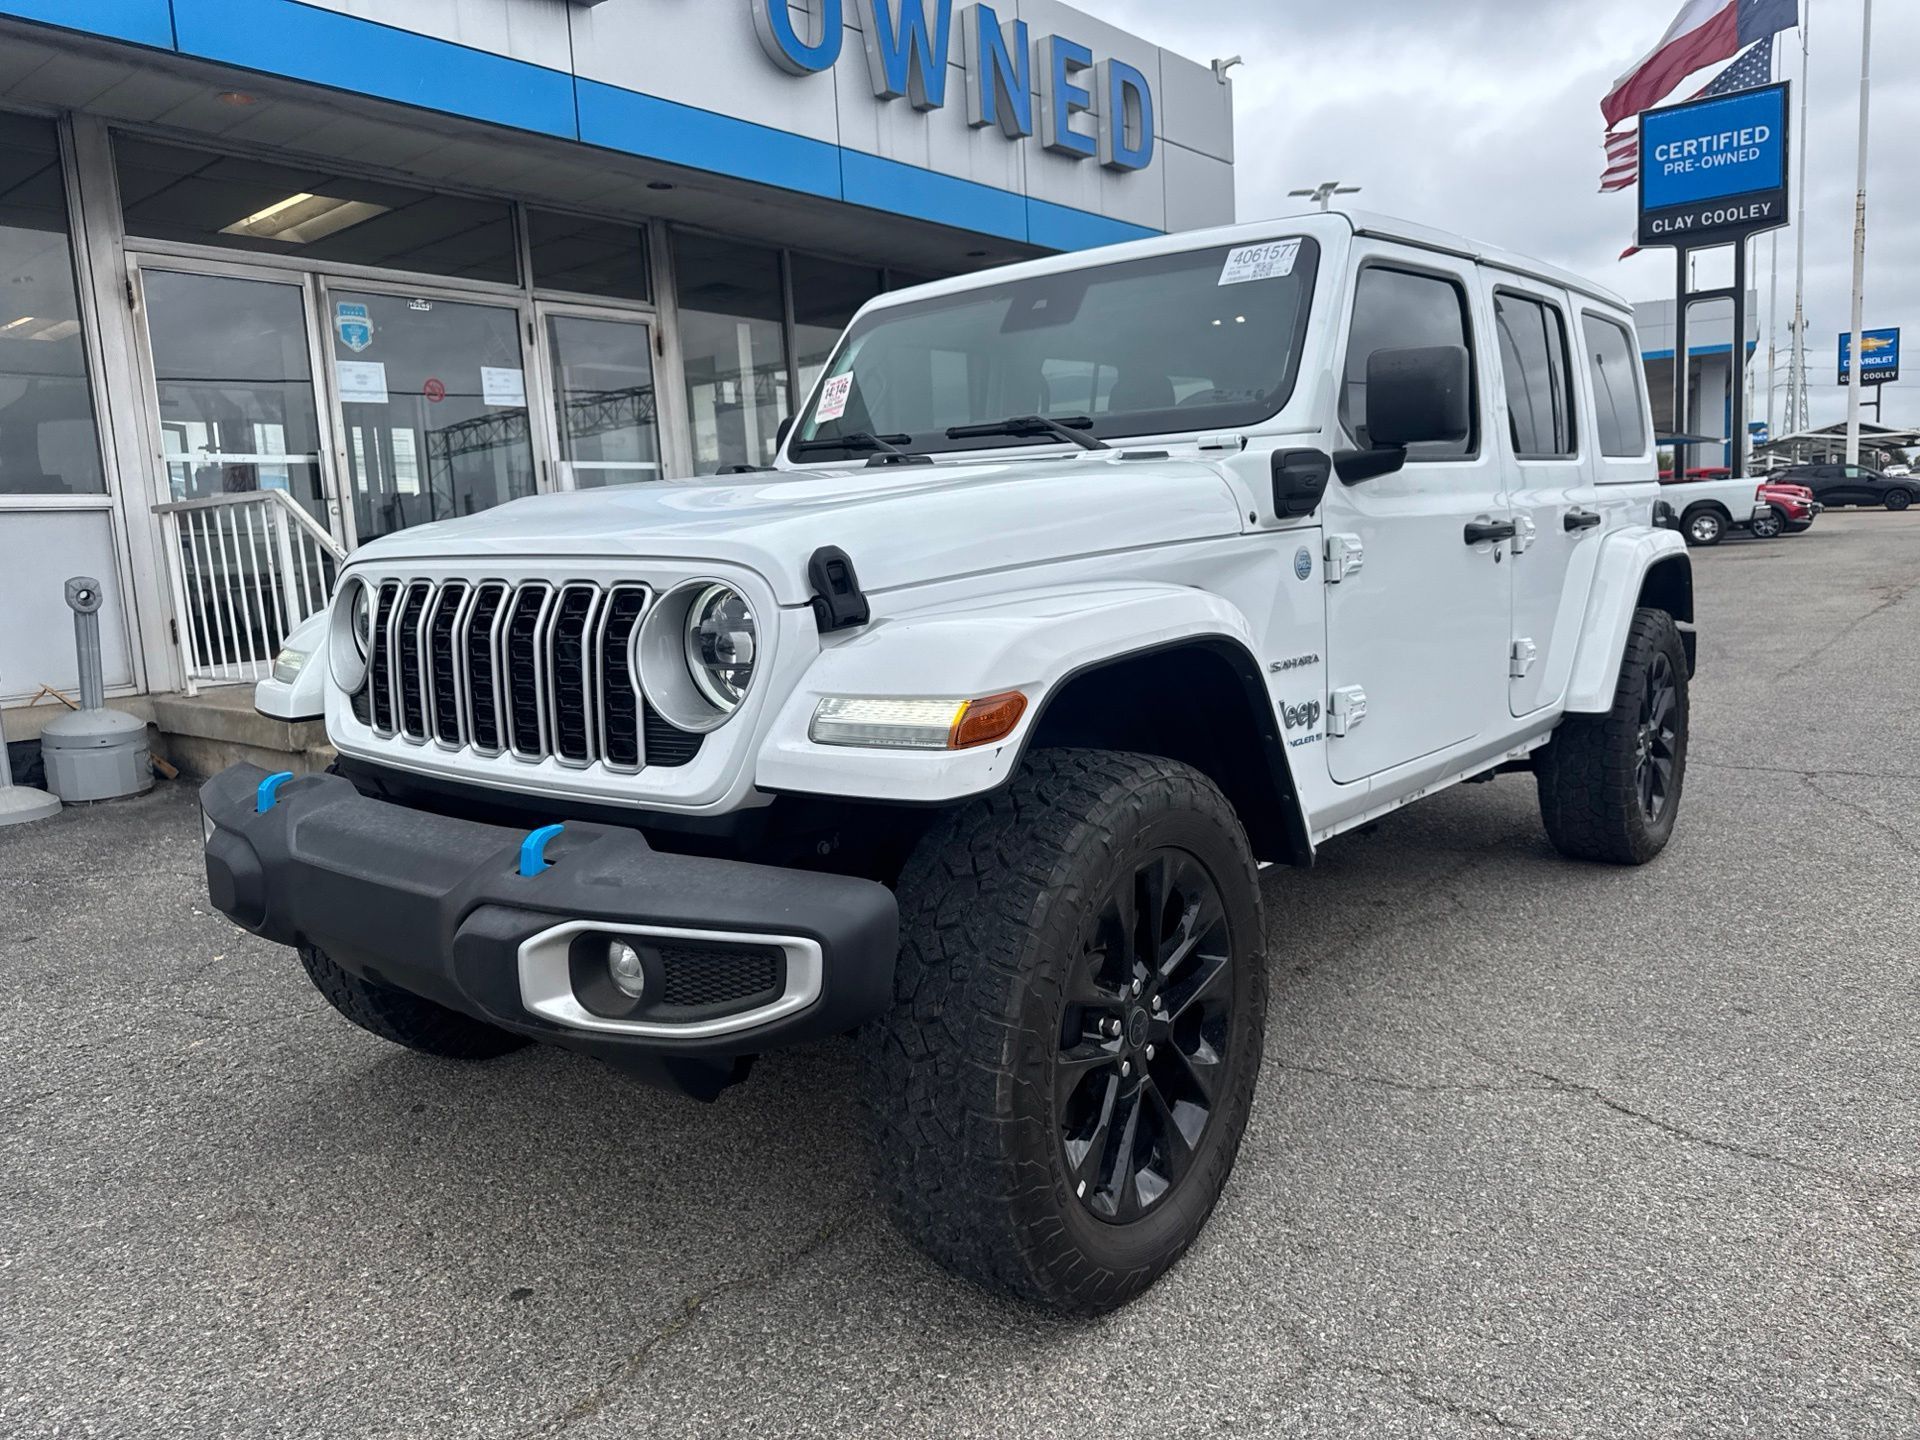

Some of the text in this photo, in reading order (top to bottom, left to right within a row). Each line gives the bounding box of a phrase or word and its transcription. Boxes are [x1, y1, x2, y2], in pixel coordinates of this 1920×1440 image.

[1654, 125, 1771, 162] CERTIFIED
[1663, 147, 1760, 176] PRE-OWNED
[1652, 202, 1772, 233] CLAY COOLEY
[1233, 242, 1301, 266] 4061577
[1843, 355, 1894, 367] CVROLET
[1863, 371, 1896, 381] COOLEY
[1269, 653, 1320, 673] SAHARA
